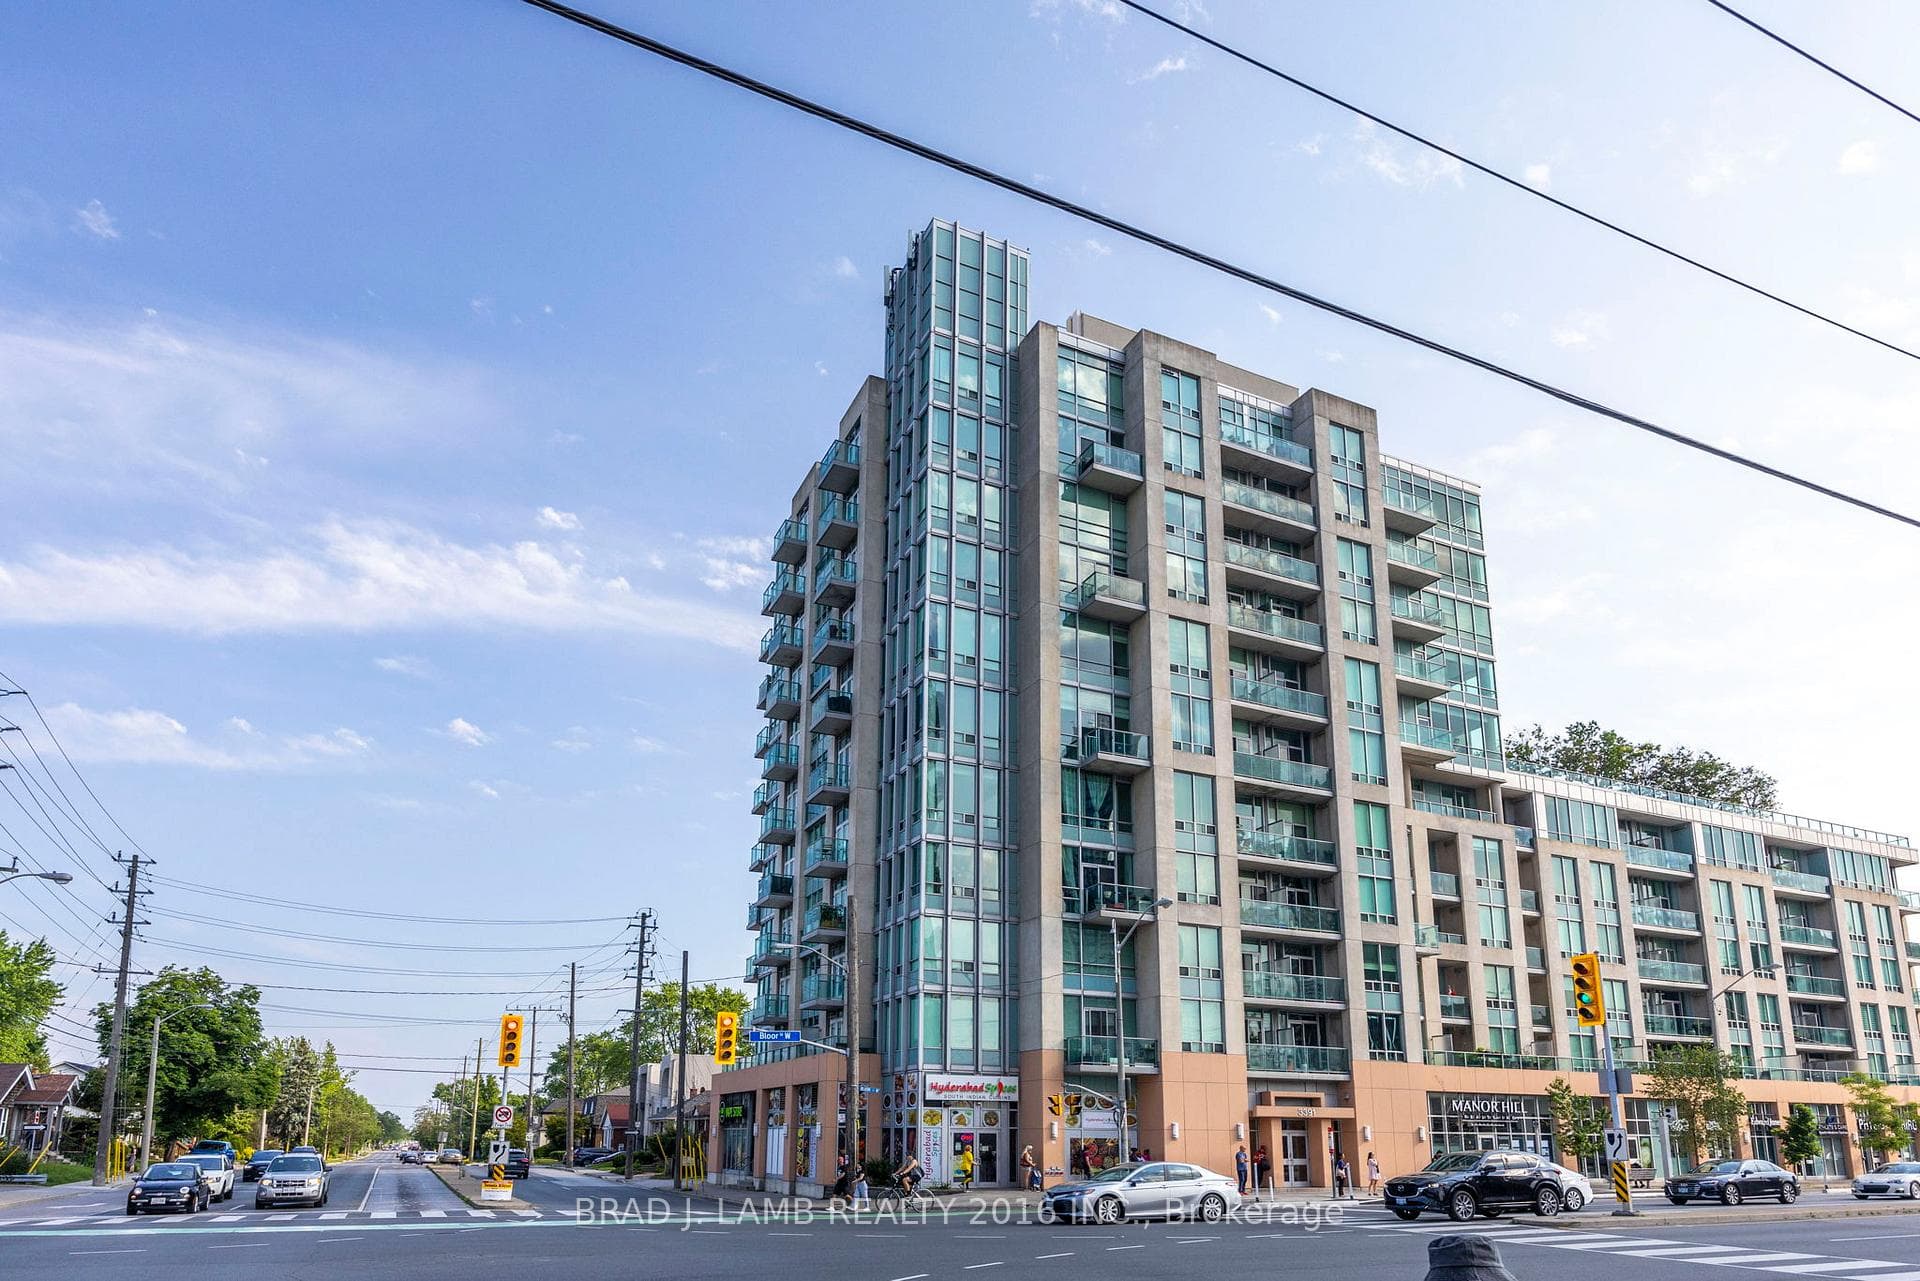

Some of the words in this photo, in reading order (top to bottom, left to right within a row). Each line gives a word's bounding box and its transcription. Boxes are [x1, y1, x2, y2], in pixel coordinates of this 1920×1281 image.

[760, 1032, 778, 1040] Bloor
[784, 1032, 791, 1040] W
[930, 1081, 985, 1094] Hyderabad
[1452, 1099, 1499, 1112] MANOR
[1501, 1101, 1528, 1114] HILL
[923, 1129, 934, 1181] Hyderabad
